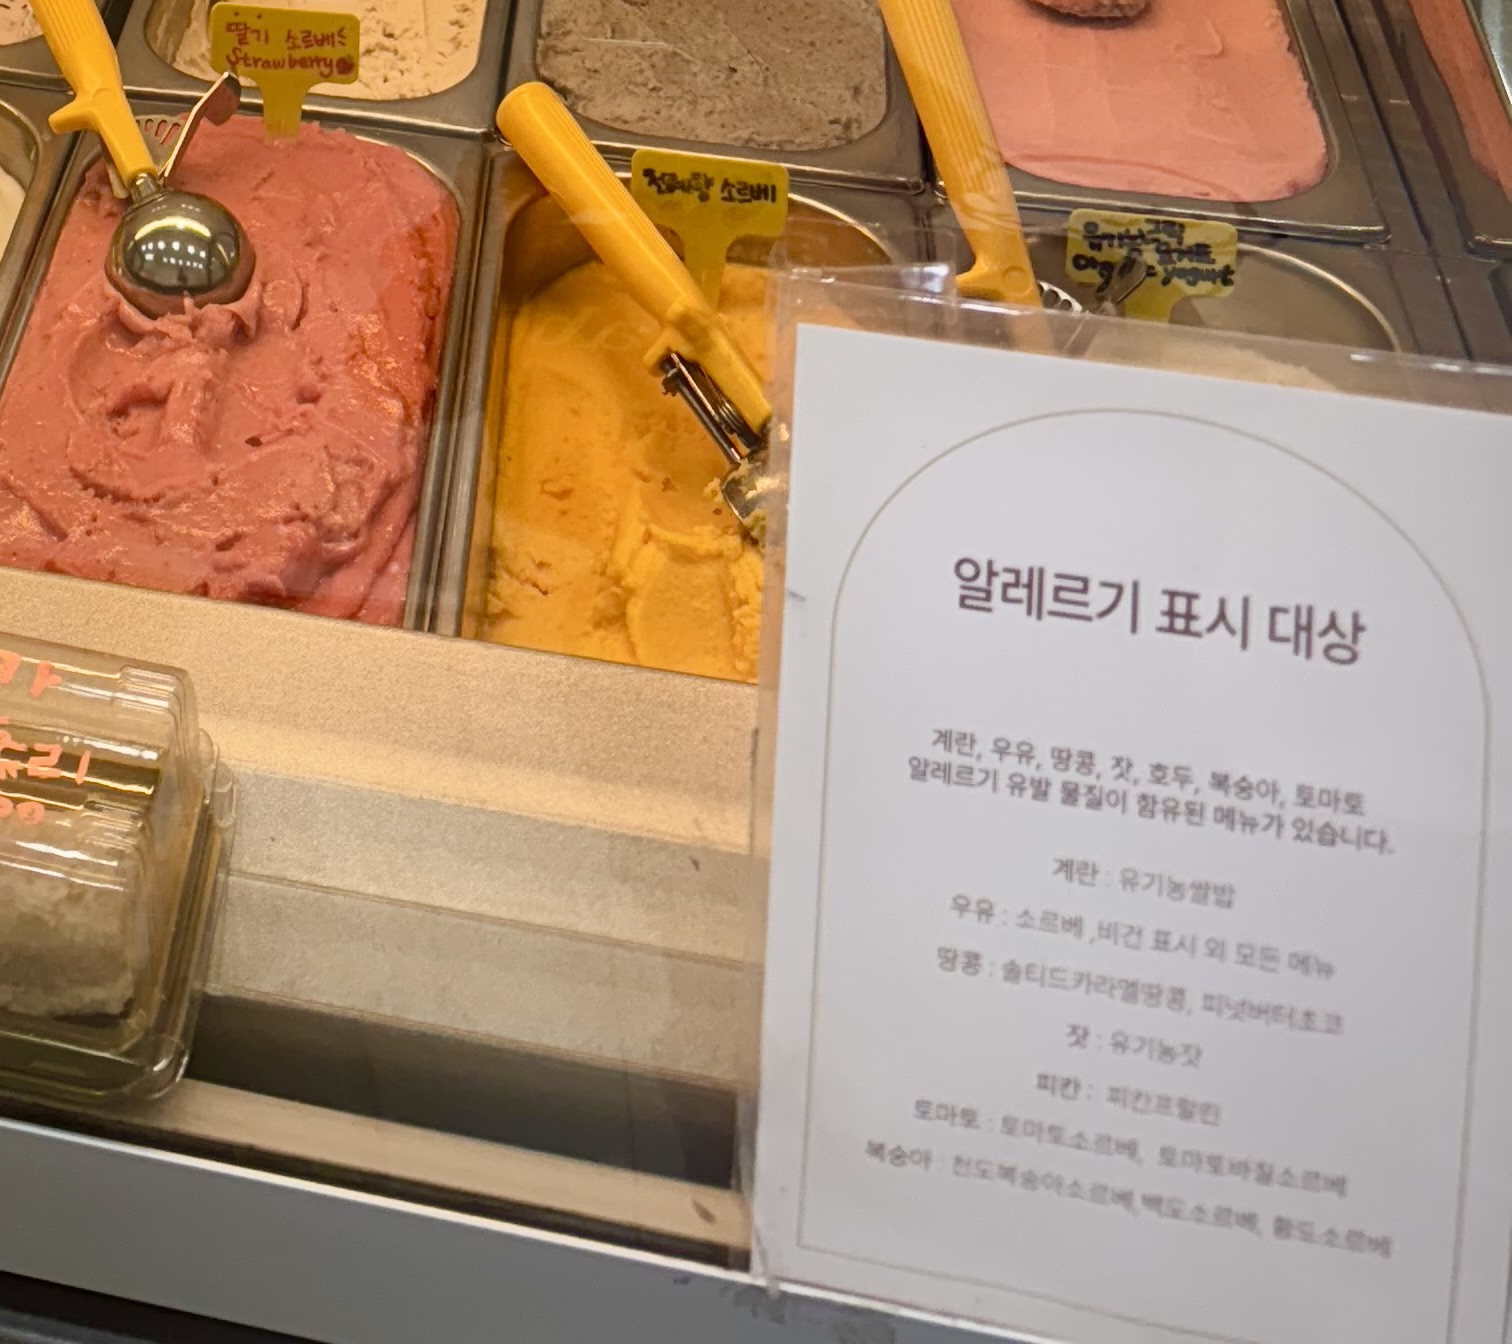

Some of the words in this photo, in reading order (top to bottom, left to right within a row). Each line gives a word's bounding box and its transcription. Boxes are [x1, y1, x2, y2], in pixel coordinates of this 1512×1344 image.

[226, 21, 270, 47] 딸기
[285, 27, 336, 51] 소르베
[225, 46, 334, 80] Strawberry
[720, 177, 778, 205] 소르베
[1071, 253, 1159, 295] Orgc
[953, 555, 1141, 637] 알레르기
[1155, 587, 1253, 652] 표시
[1266, 601, 1368, 667] 대상
[931, 727, 984, 763] 계란,
[990, 736, 1043, 772] 우유,
[1050, 745, 1102, 782] 땅콩,
[1110, 753, 1139, 787] 잣,
[1147, 760, 1202, 796] 호두,
[1209, 769, 1286, 809] 복숭아,
[1293, 783, 1367, 817] 토마토
[907, 755, 1000, 794] 알레르기
[1007, 770, 1051, 803] 유발
[1059, 781, 1129, 815] 물질이
[1135, 791, 1208, 828] 함유된
[1213, 803, 1286, 840] 메뉴가
[1291, 816, 1395, 857] 있습니다.
[1052, 855, 1100, 888] 계란
[1118, 865, 1237, 910] 유기농쌀밥
[949, 891, 996, 926] 우유
[1014, 907, 1084, 941] 소르베
[1148, 926, 1198, 960] 표시
[1202, 936, 1228, 964] 외
[1233, 941, 1283, 975] 모든
[1286, 949, 1337, 983] 메뉴
[936, 943, 985, 977] 땅콩
[1065, 1020, 1091, 1050] 잣
[1108, 1028, 1204, 1072] 유기농잣
[1036, 1072, 1082, 1101] 피칸
[913, 1098, 982, 1130] 토마토
[864, 1138, 934, 1172] 복숭아
